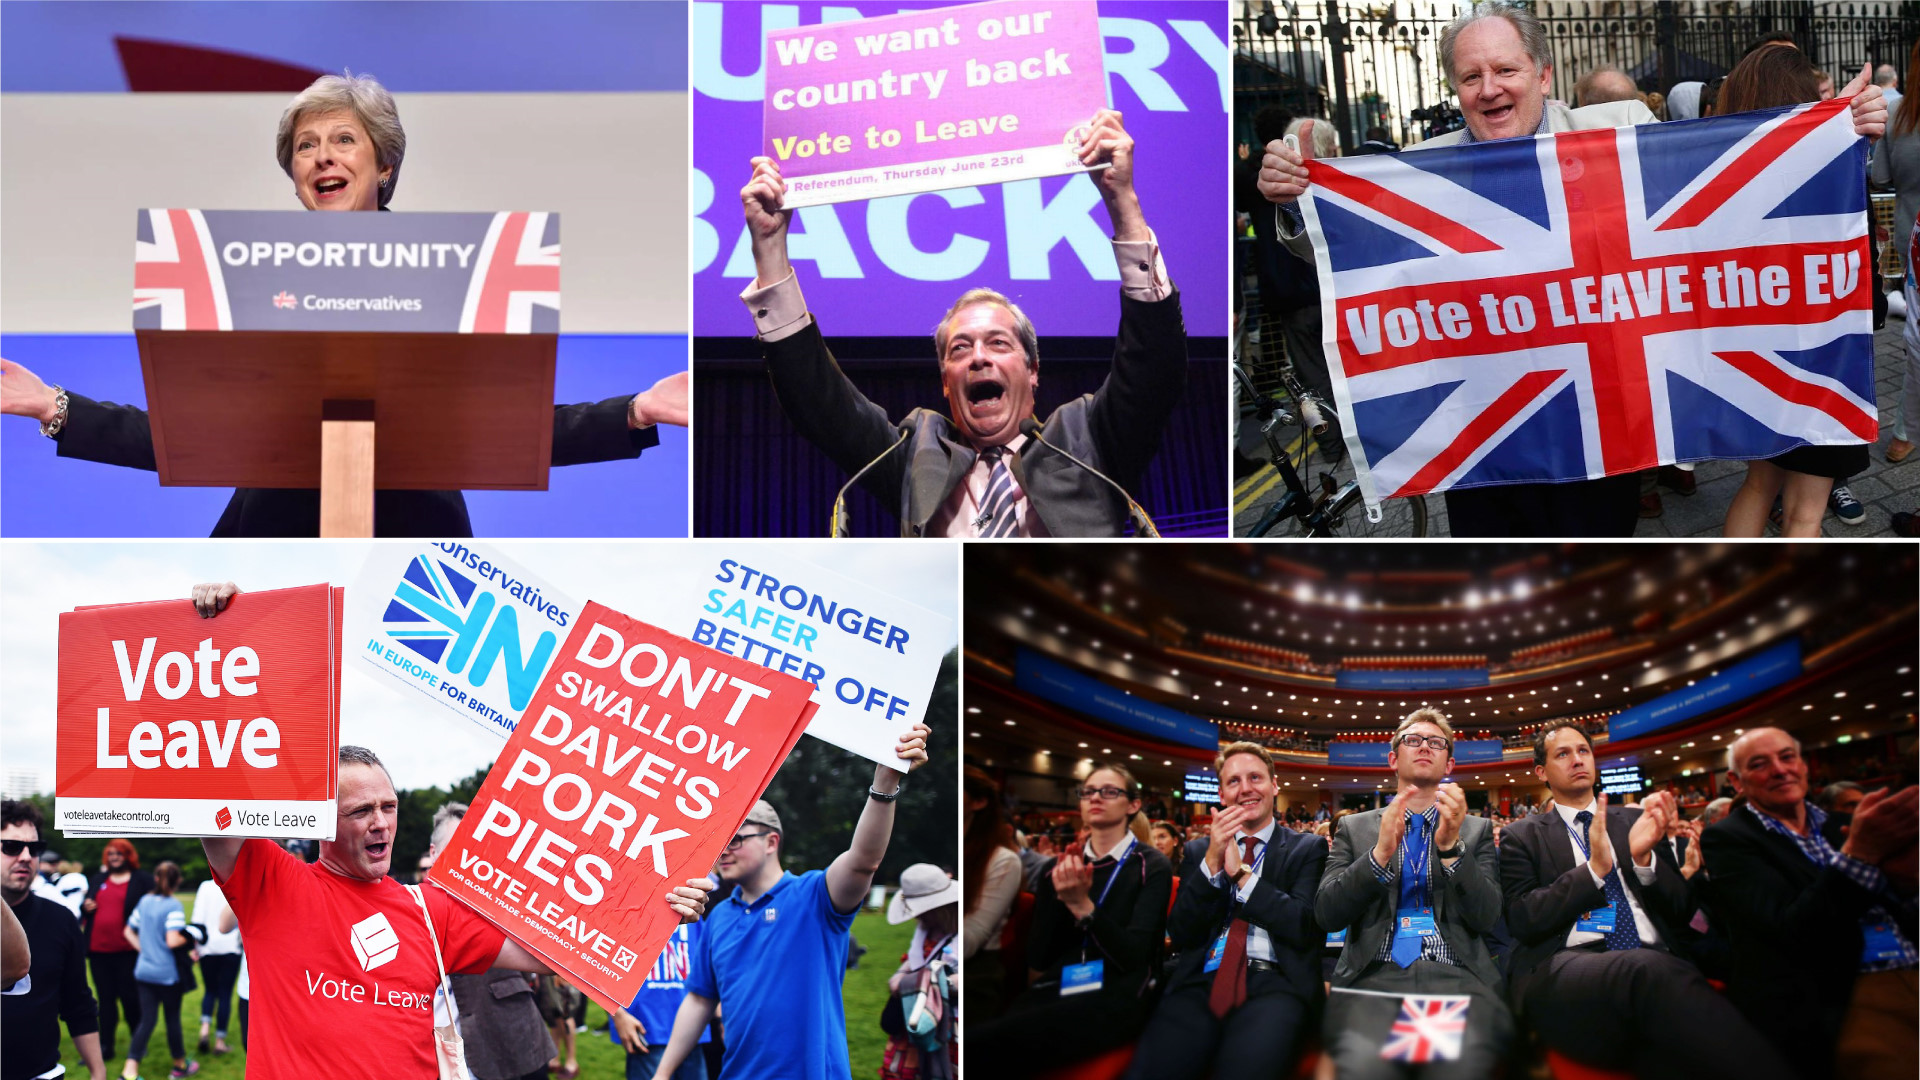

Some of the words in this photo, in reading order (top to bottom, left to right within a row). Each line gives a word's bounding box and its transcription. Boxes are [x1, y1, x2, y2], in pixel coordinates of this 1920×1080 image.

[773, 69, 948, 111] country
[966, 48, 1072, 87] back
[775, 37, 838, 66] We
[854, 18, 960, 56] want
[977, 11, 1052, 41] our
[772, 131, 851, 161] Vote
[865, 126, 901, 149] to
[916, 114, 1019, 144] Leave
[794, 174, 878, 192] Referendum,
[883, 165, 946, 181] Thursday
[952, 159, 985, 172] June
[991, 155, 1024, 168] 23rd
[223, 241, 476, 269] OPPORTUNITY
[303, 293, 422, 313] Conservatives
[1345, 302, 1473, 357] Vote
[1484, 294, 1537, 336] to
[1546, 265, 1694, 324] LEAVE
[1702, 265, 1792, 310] the
[1803, 250, 1859, 306] EU
[431, 543, 570, 627] onservatives
[703, 588, 818, 653] SAFER
[715, 559, 910, 655] STRONGER
[112, 637, 261, 702] Vote
[367, 639, 385, 656] IN
[384, 649, 439, 687] EUROPE
[439, 681, 467, 704] FOR
[467, 698, 518, 733] BRITAIN
[446, 591, 557, 712] IN
[575, 621, 772, 727] DON'T
[692, 618, 826, 691] BETTER
[835, 677, 910, 721] OFF
[96, 707, 281, 770] Leave
[529, 704, 720, 820] DAVE'S
[555, 671, 751, 772] SWALLOW
[63, 810, 170, 824] voteleavetakecontrol.org
[238, 810, 270, 827] Vote
[274, 811, 317, 828] Leave
[472, 799, 613, 906] PIES
[501, 748, 691, 879] PORK
[448, 868, 465, 882] FOR
[464, 878, 493, 901] GLOBAL
[494, 896, 520, 917] TRADE
[524, 917, 576, 952] DEMOCRACY
[580, 952, 624, 982] SECURITY
[459, 848, 527, 903] VOTE
[525, 891, 616, 959] LEAVE
[305, 970, 365, 1003] Vote
[374, 982, 431, 1011] Leave
